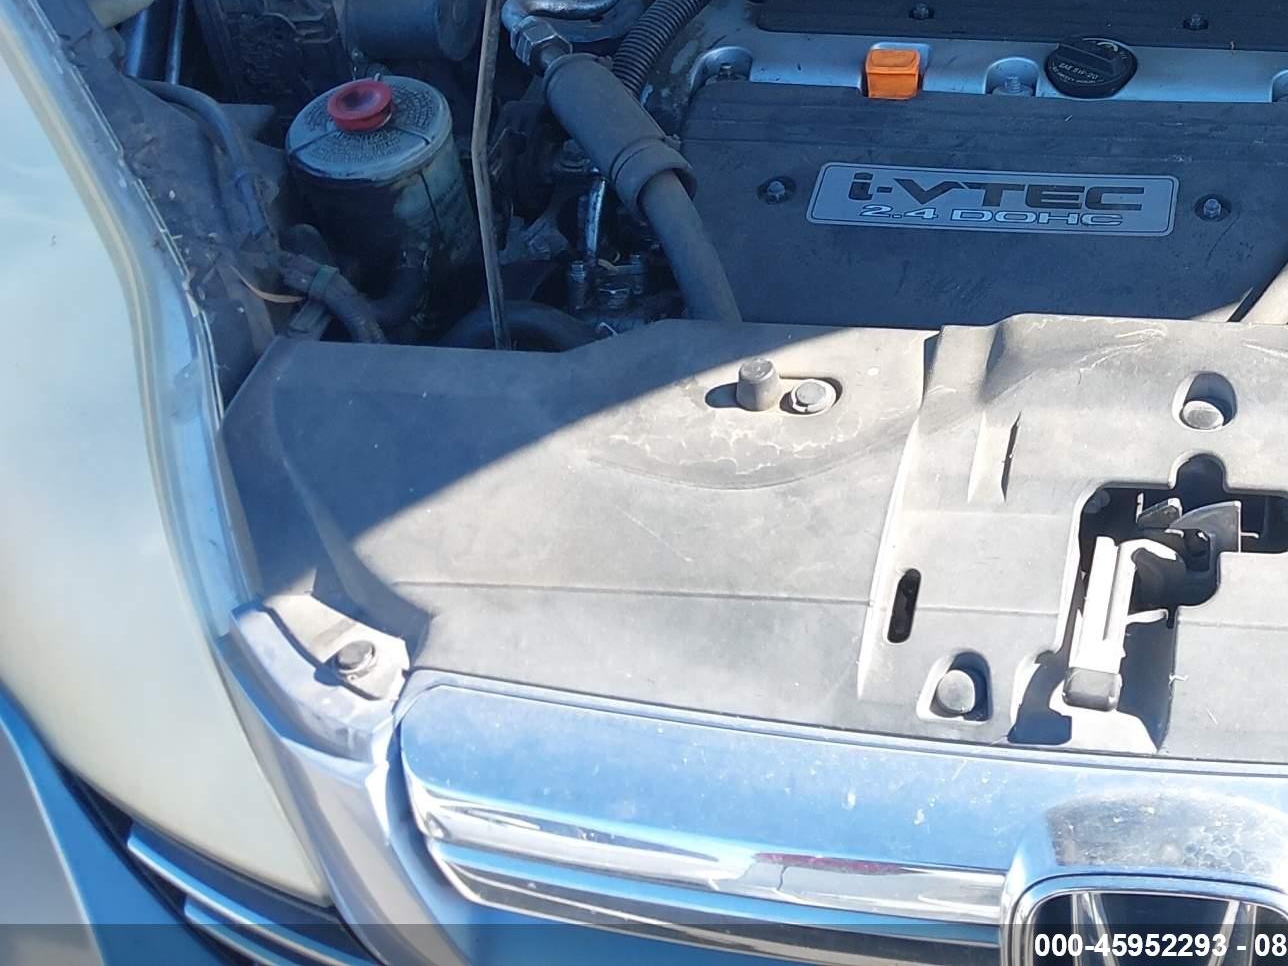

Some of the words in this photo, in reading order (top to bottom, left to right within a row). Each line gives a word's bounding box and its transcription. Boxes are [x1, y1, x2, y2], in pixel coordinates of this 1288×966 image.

[847, 171, 1144, 212] i-VTEC
[859, 204, 939, 221] 2.4
[950, 209, 1124, 227] DOHC
